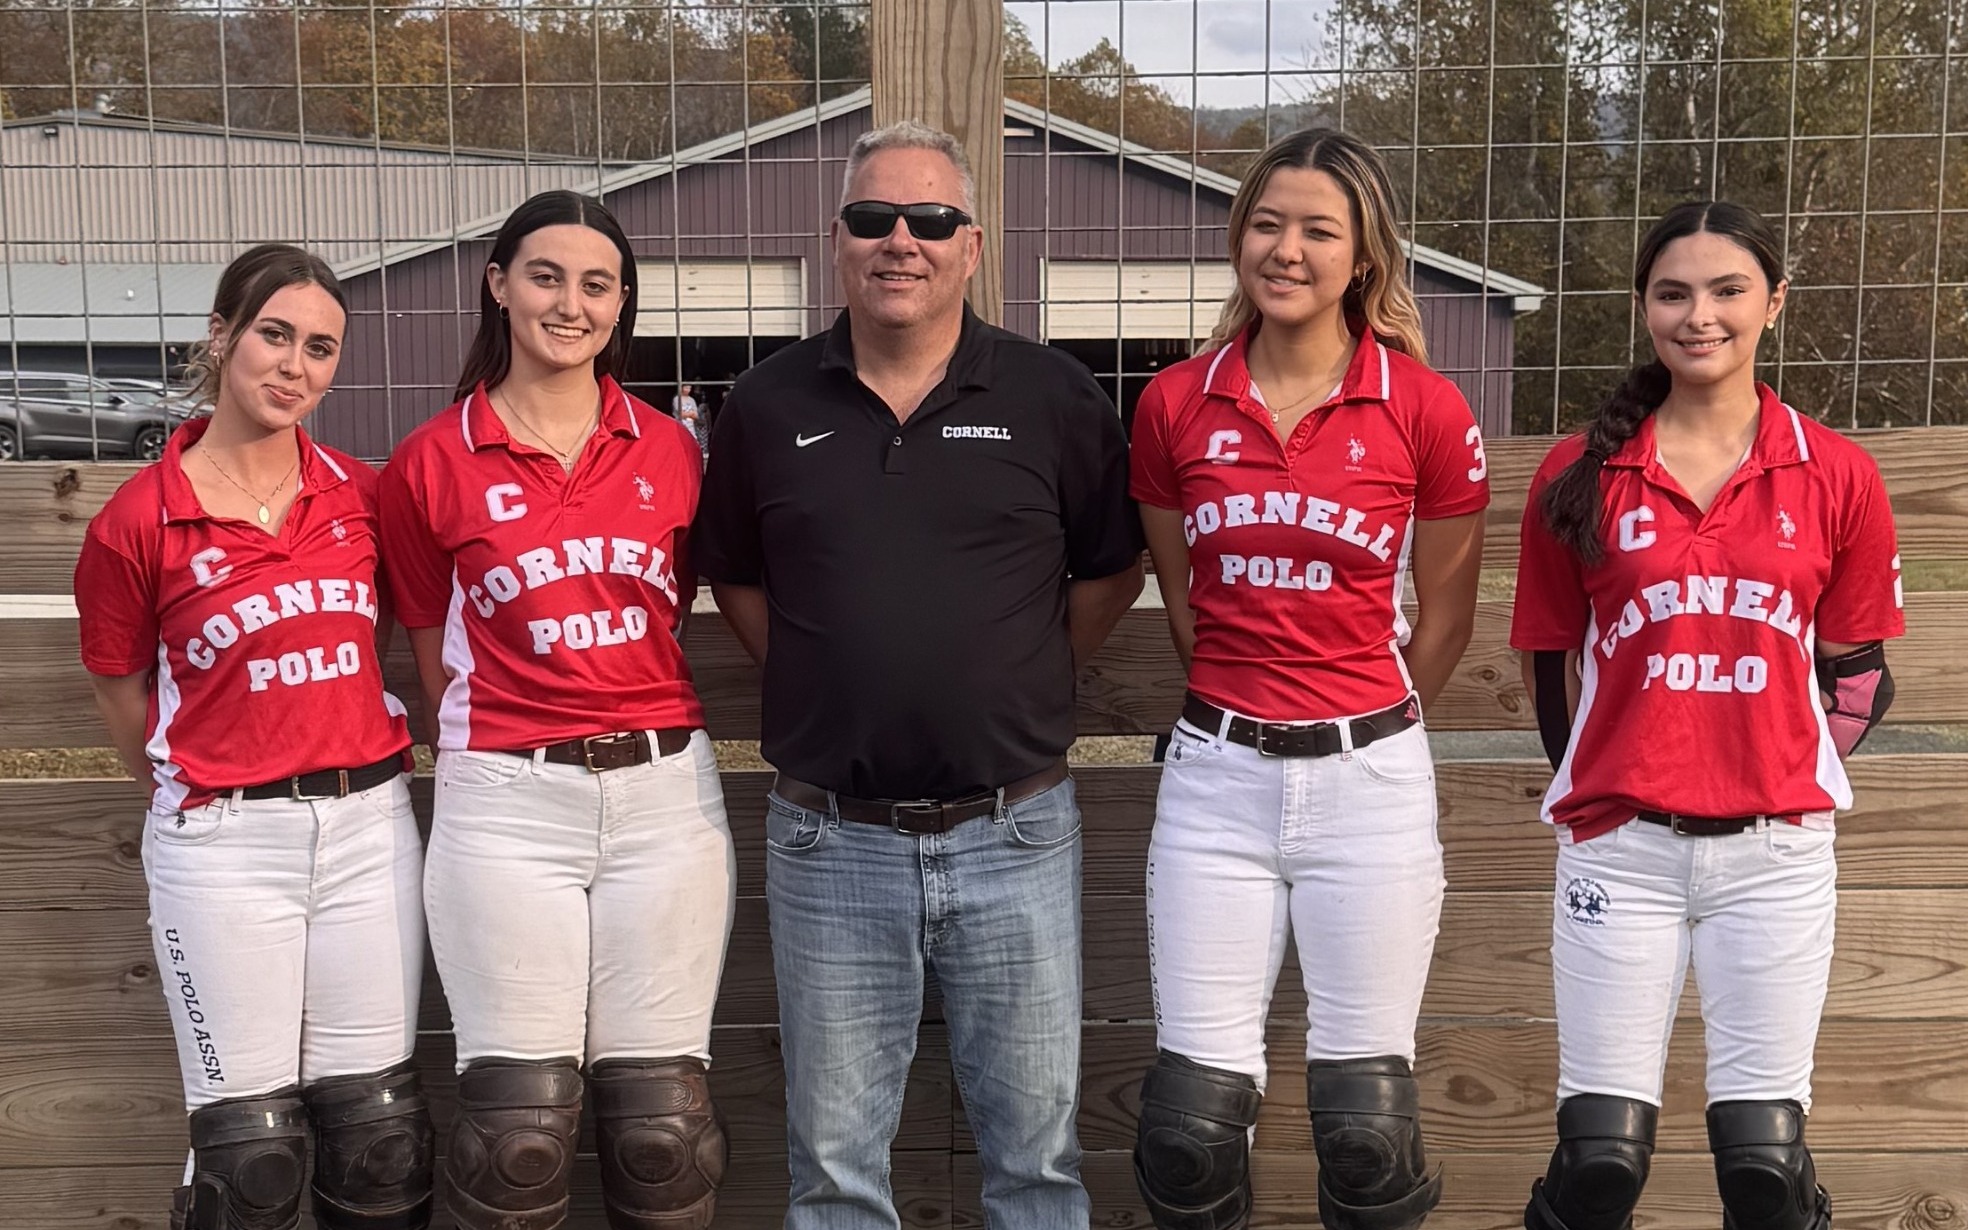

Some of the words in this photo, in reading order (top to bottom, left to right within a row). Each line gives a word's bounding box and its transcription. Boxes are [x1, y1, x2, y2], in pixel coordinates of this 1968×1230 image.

[942, 426, 1011, 440] CORNELL
[1204, 429, 1242, 465] C
[1465, 424, 1488, 483] 3
[485, 482, 528, 522] C
[1183, 491, 1396, 563] CORNELL
[1618, 504, 1657, 553] C
[190, 546, 233, 588] C
[1220, 554, 1333, 591] POLO
[186, 578, 377, 670] CORNEL
[528, 606, 648, 655] POLO
[1600, 574, 1807, 663] CORNEL
[247, 641, 361, 692] POLO
[1642, 653, 1768, 693] POLO
[165, 928, 185, 965] U.S.
[176, 970, 205, 1024] POLO
[193, 1027, 225, 1086] ASSN.
